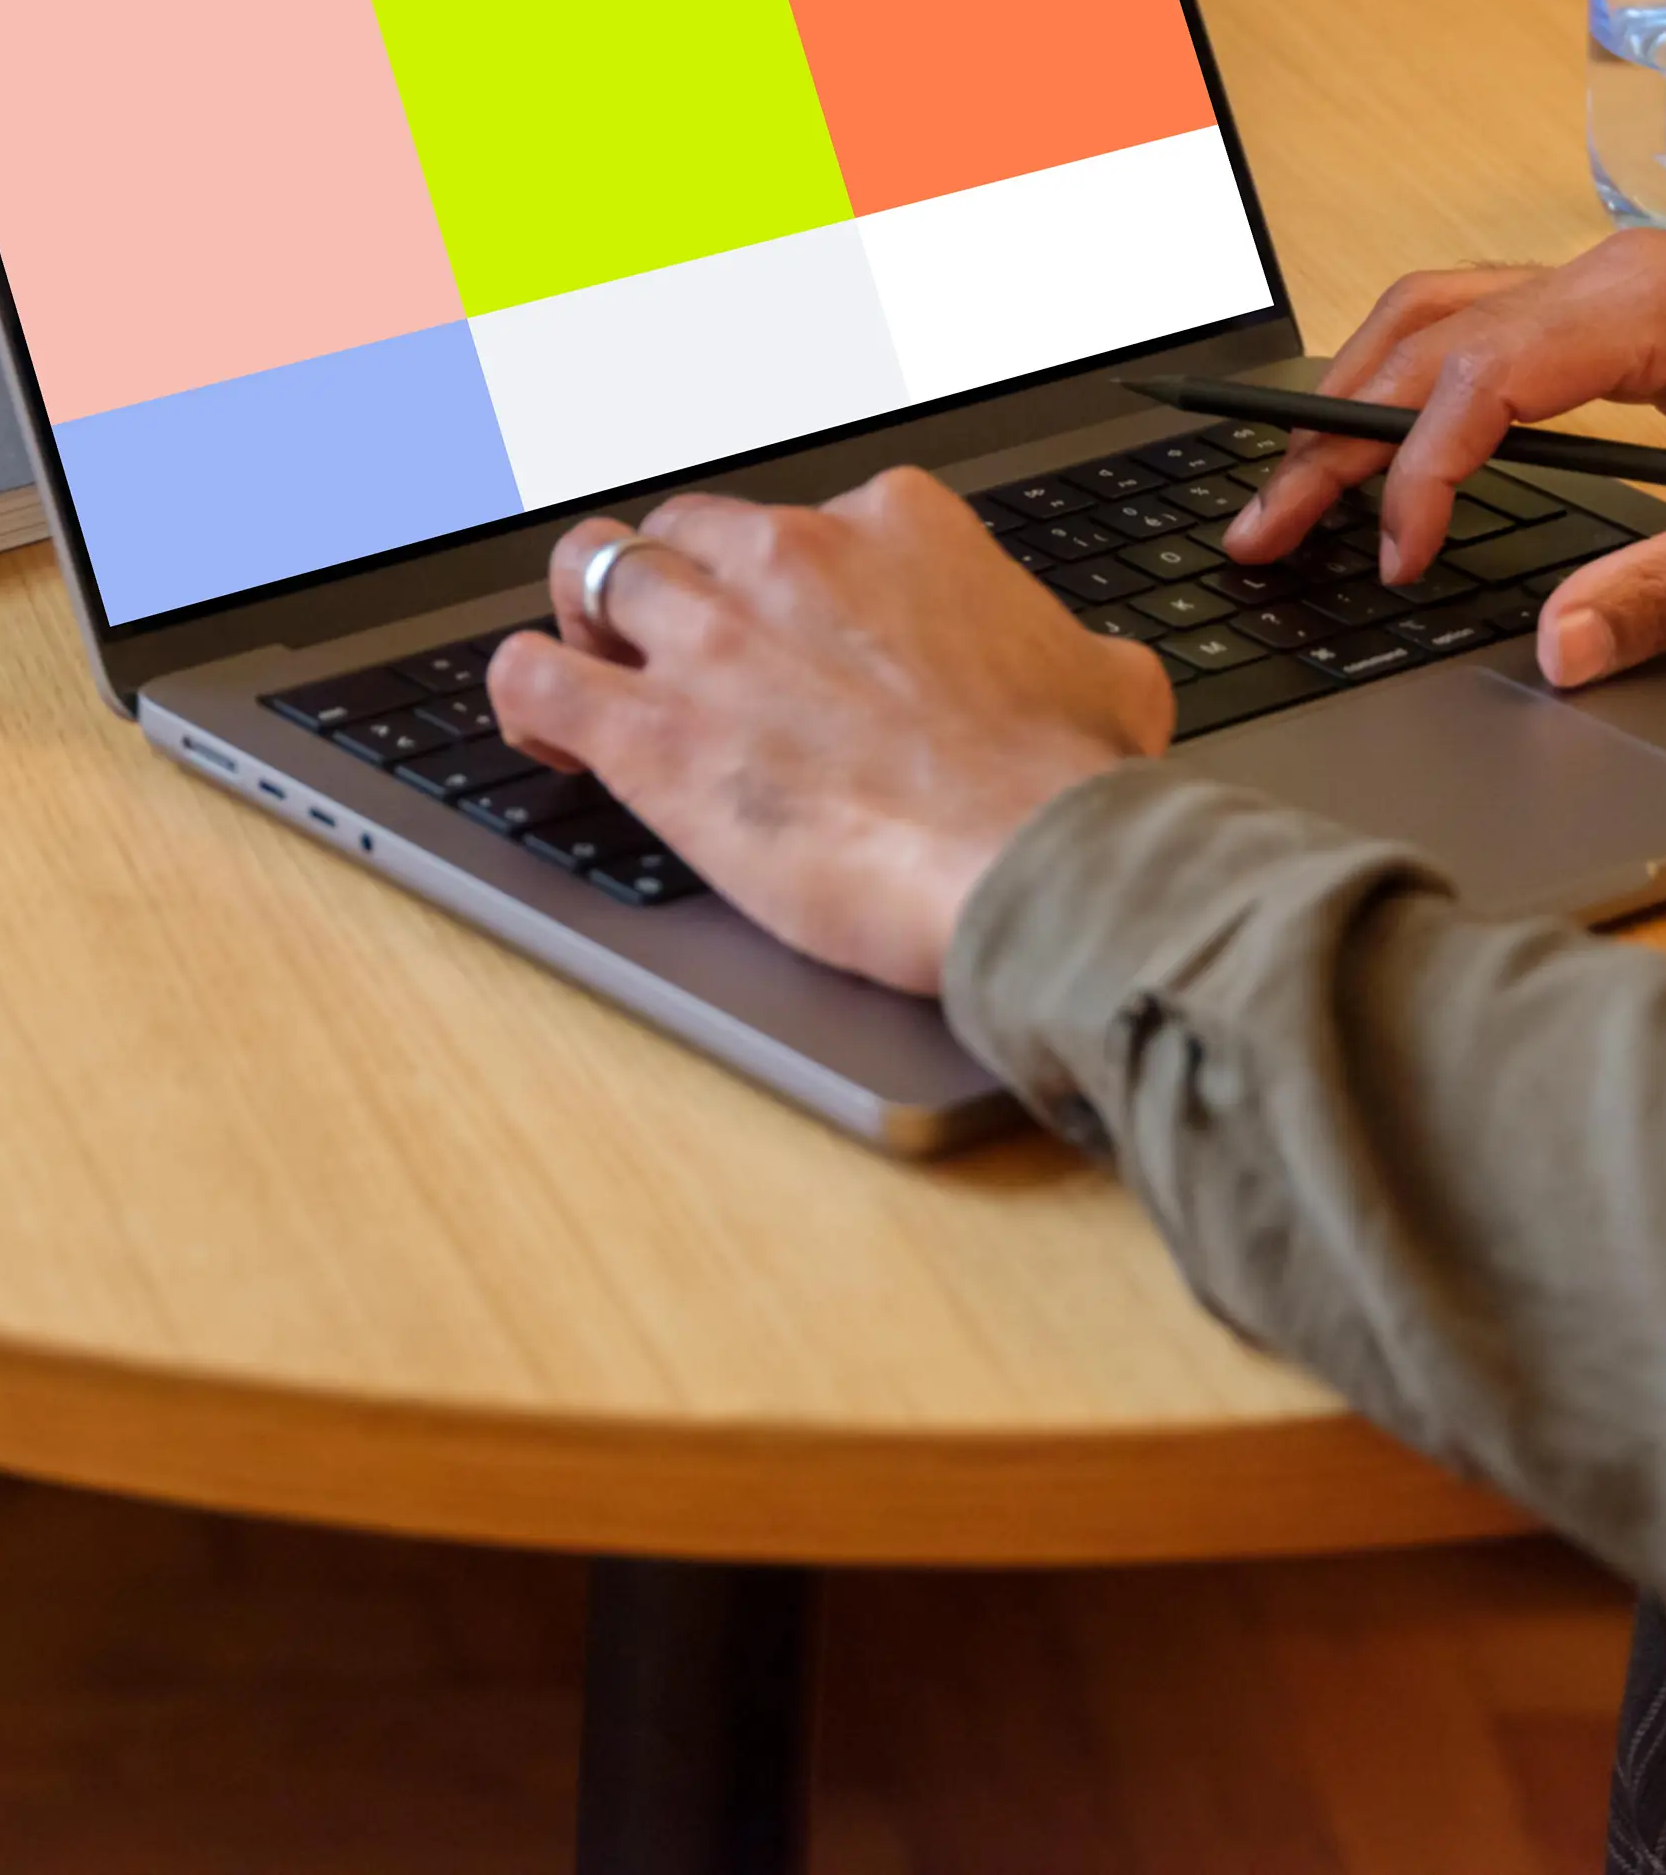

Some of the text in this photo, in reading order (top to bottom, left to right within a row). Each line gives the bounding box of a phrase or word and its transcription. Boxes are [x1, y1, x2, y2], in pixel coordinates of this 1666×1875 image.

[1160, 551, 1181, 563] O
[1242, 579, 1266, 589] L
[1169, 598, 1194, 611] K
[1199, 641, 1227, 655] M
